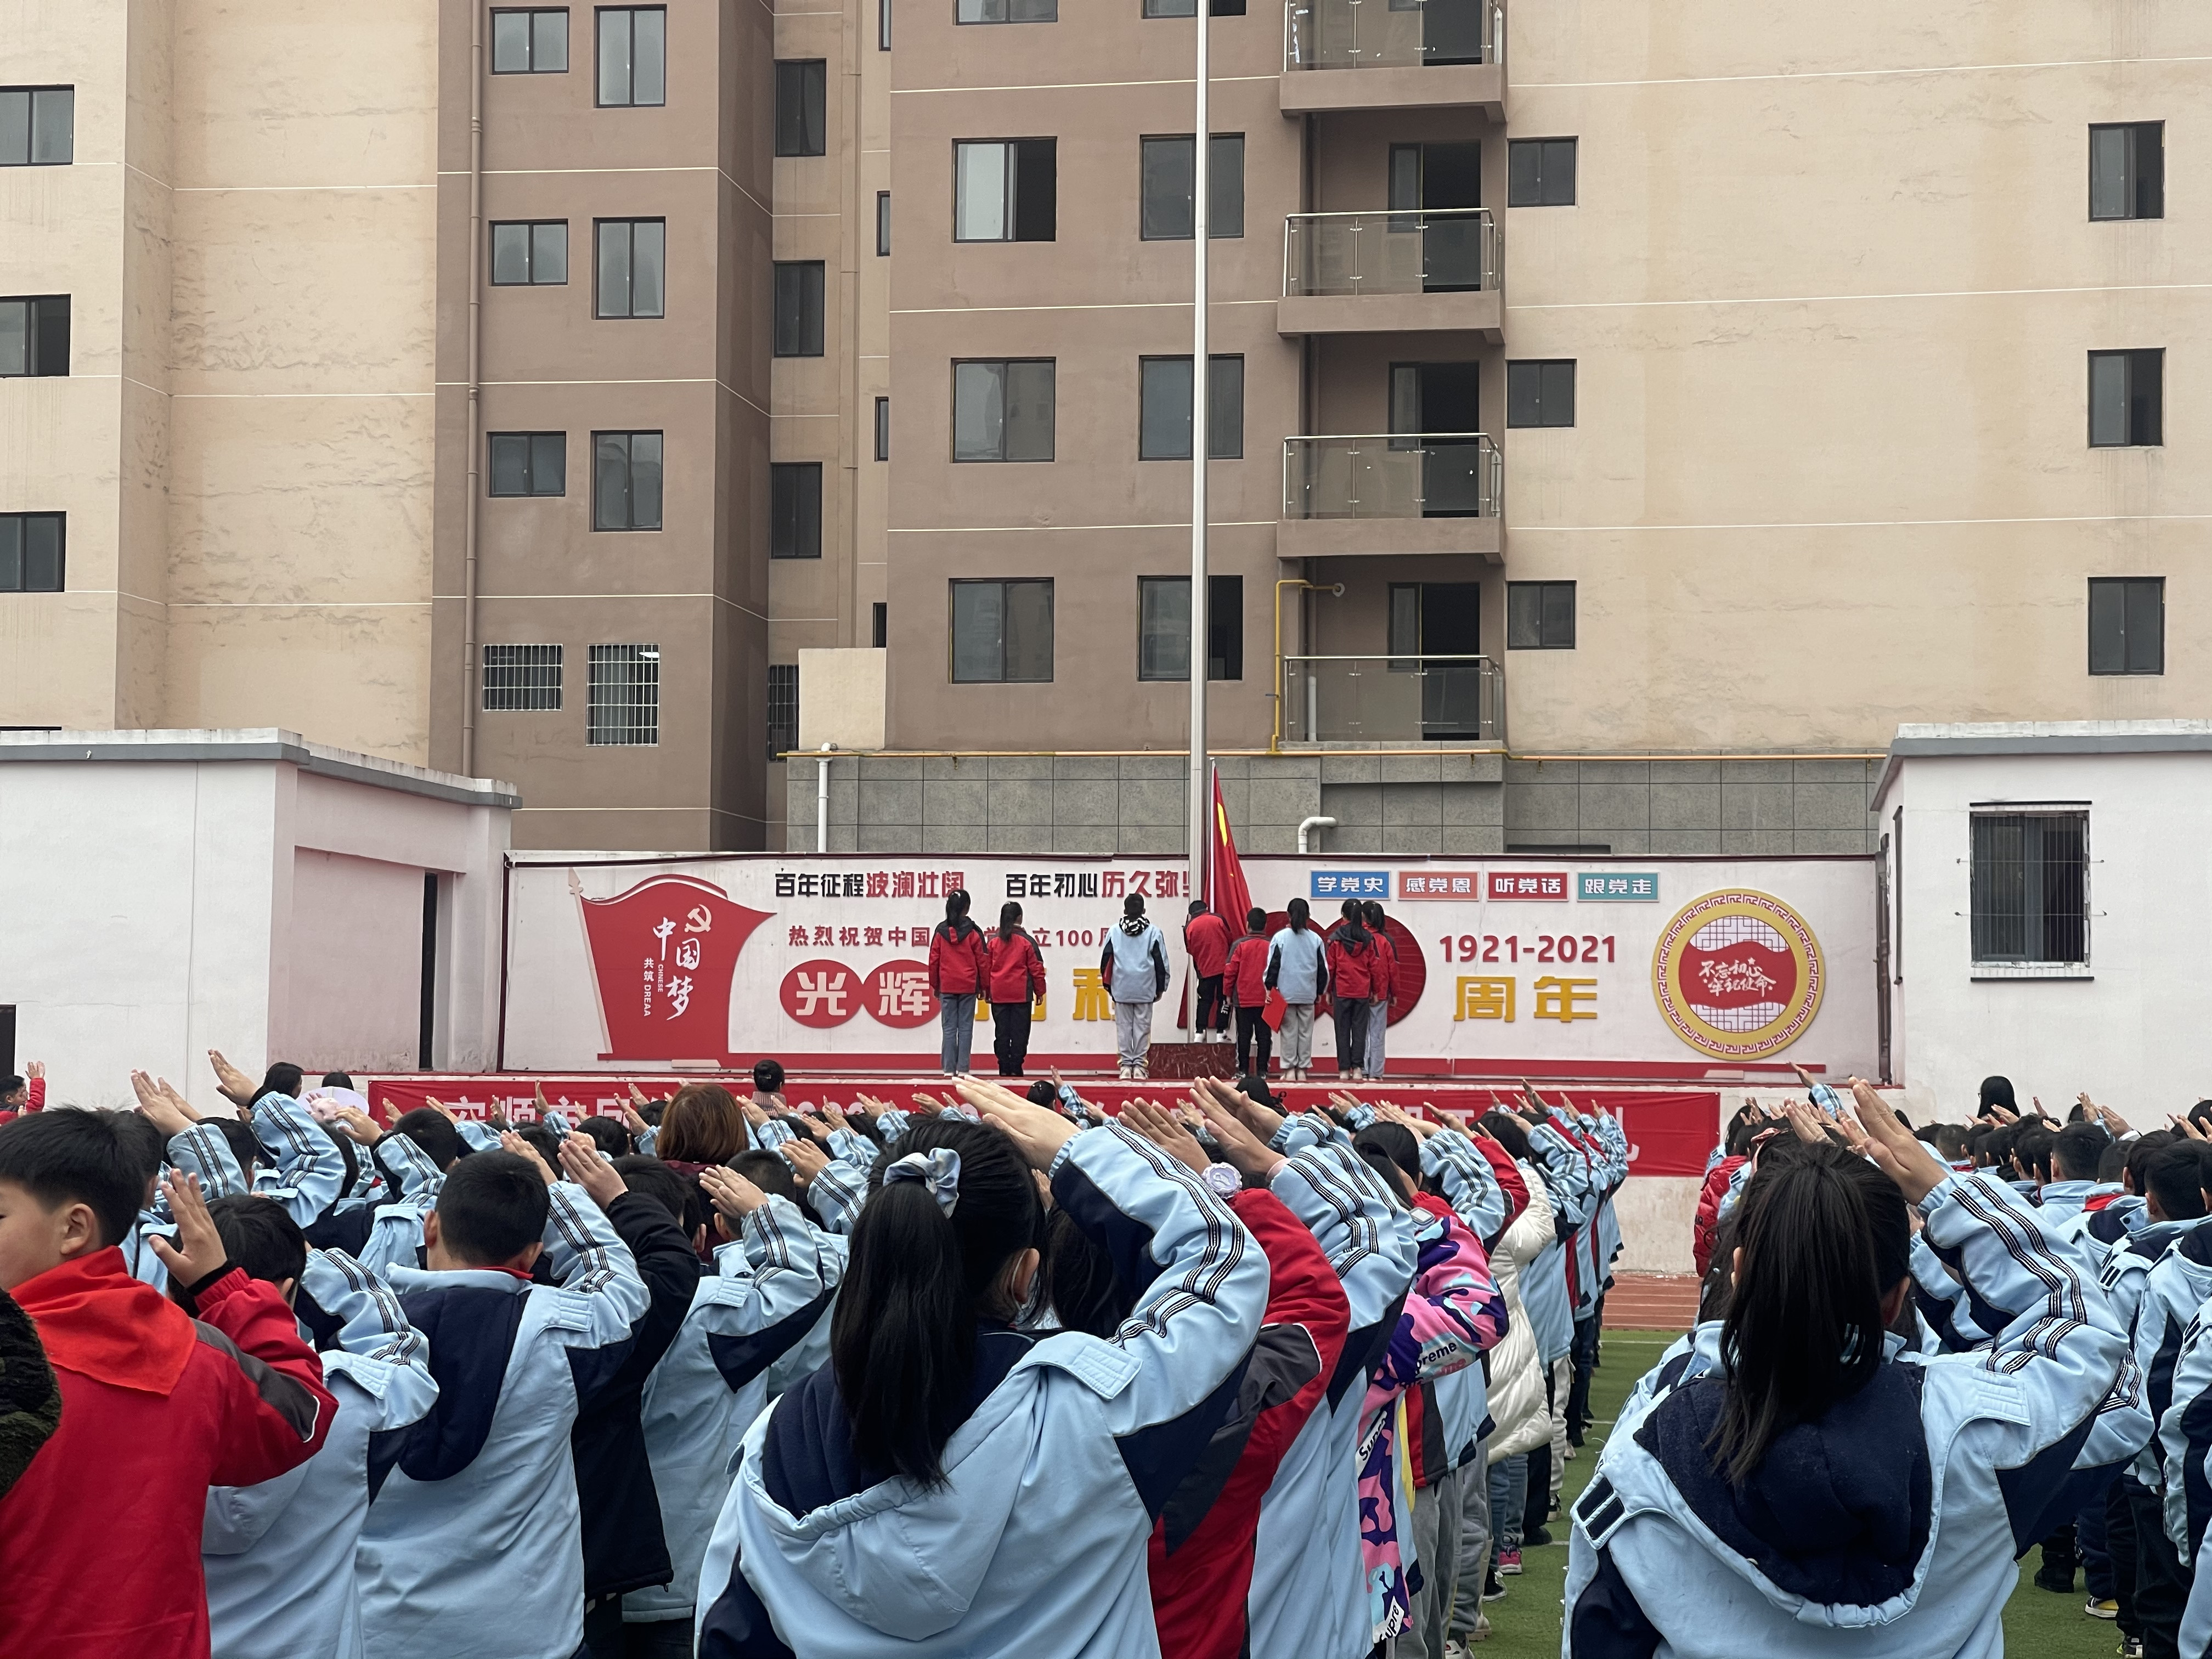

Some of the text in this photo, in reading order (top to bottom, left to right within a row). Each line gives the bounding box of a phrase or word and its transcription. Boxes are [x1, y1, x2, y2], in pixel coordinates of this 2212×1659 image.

[1317, 876, 1384, 893] 学党史
[1406, 877, 1471, 893] 感党恩
[1495, 878, 1561, 894] 听党话
[1585, 878, 1652, 895] 跟党走
[1439, 935, 1615, 963] 1921-2021
[644, 957, 654, 982] 共筑
[653, 917, 701, 1021] 中国梦
[1699, 960, 1763, 979] 不忘初心
[1708, 974, 1777, 997] 牢记使命
[1453, 975, 1598, 1023] 周年
